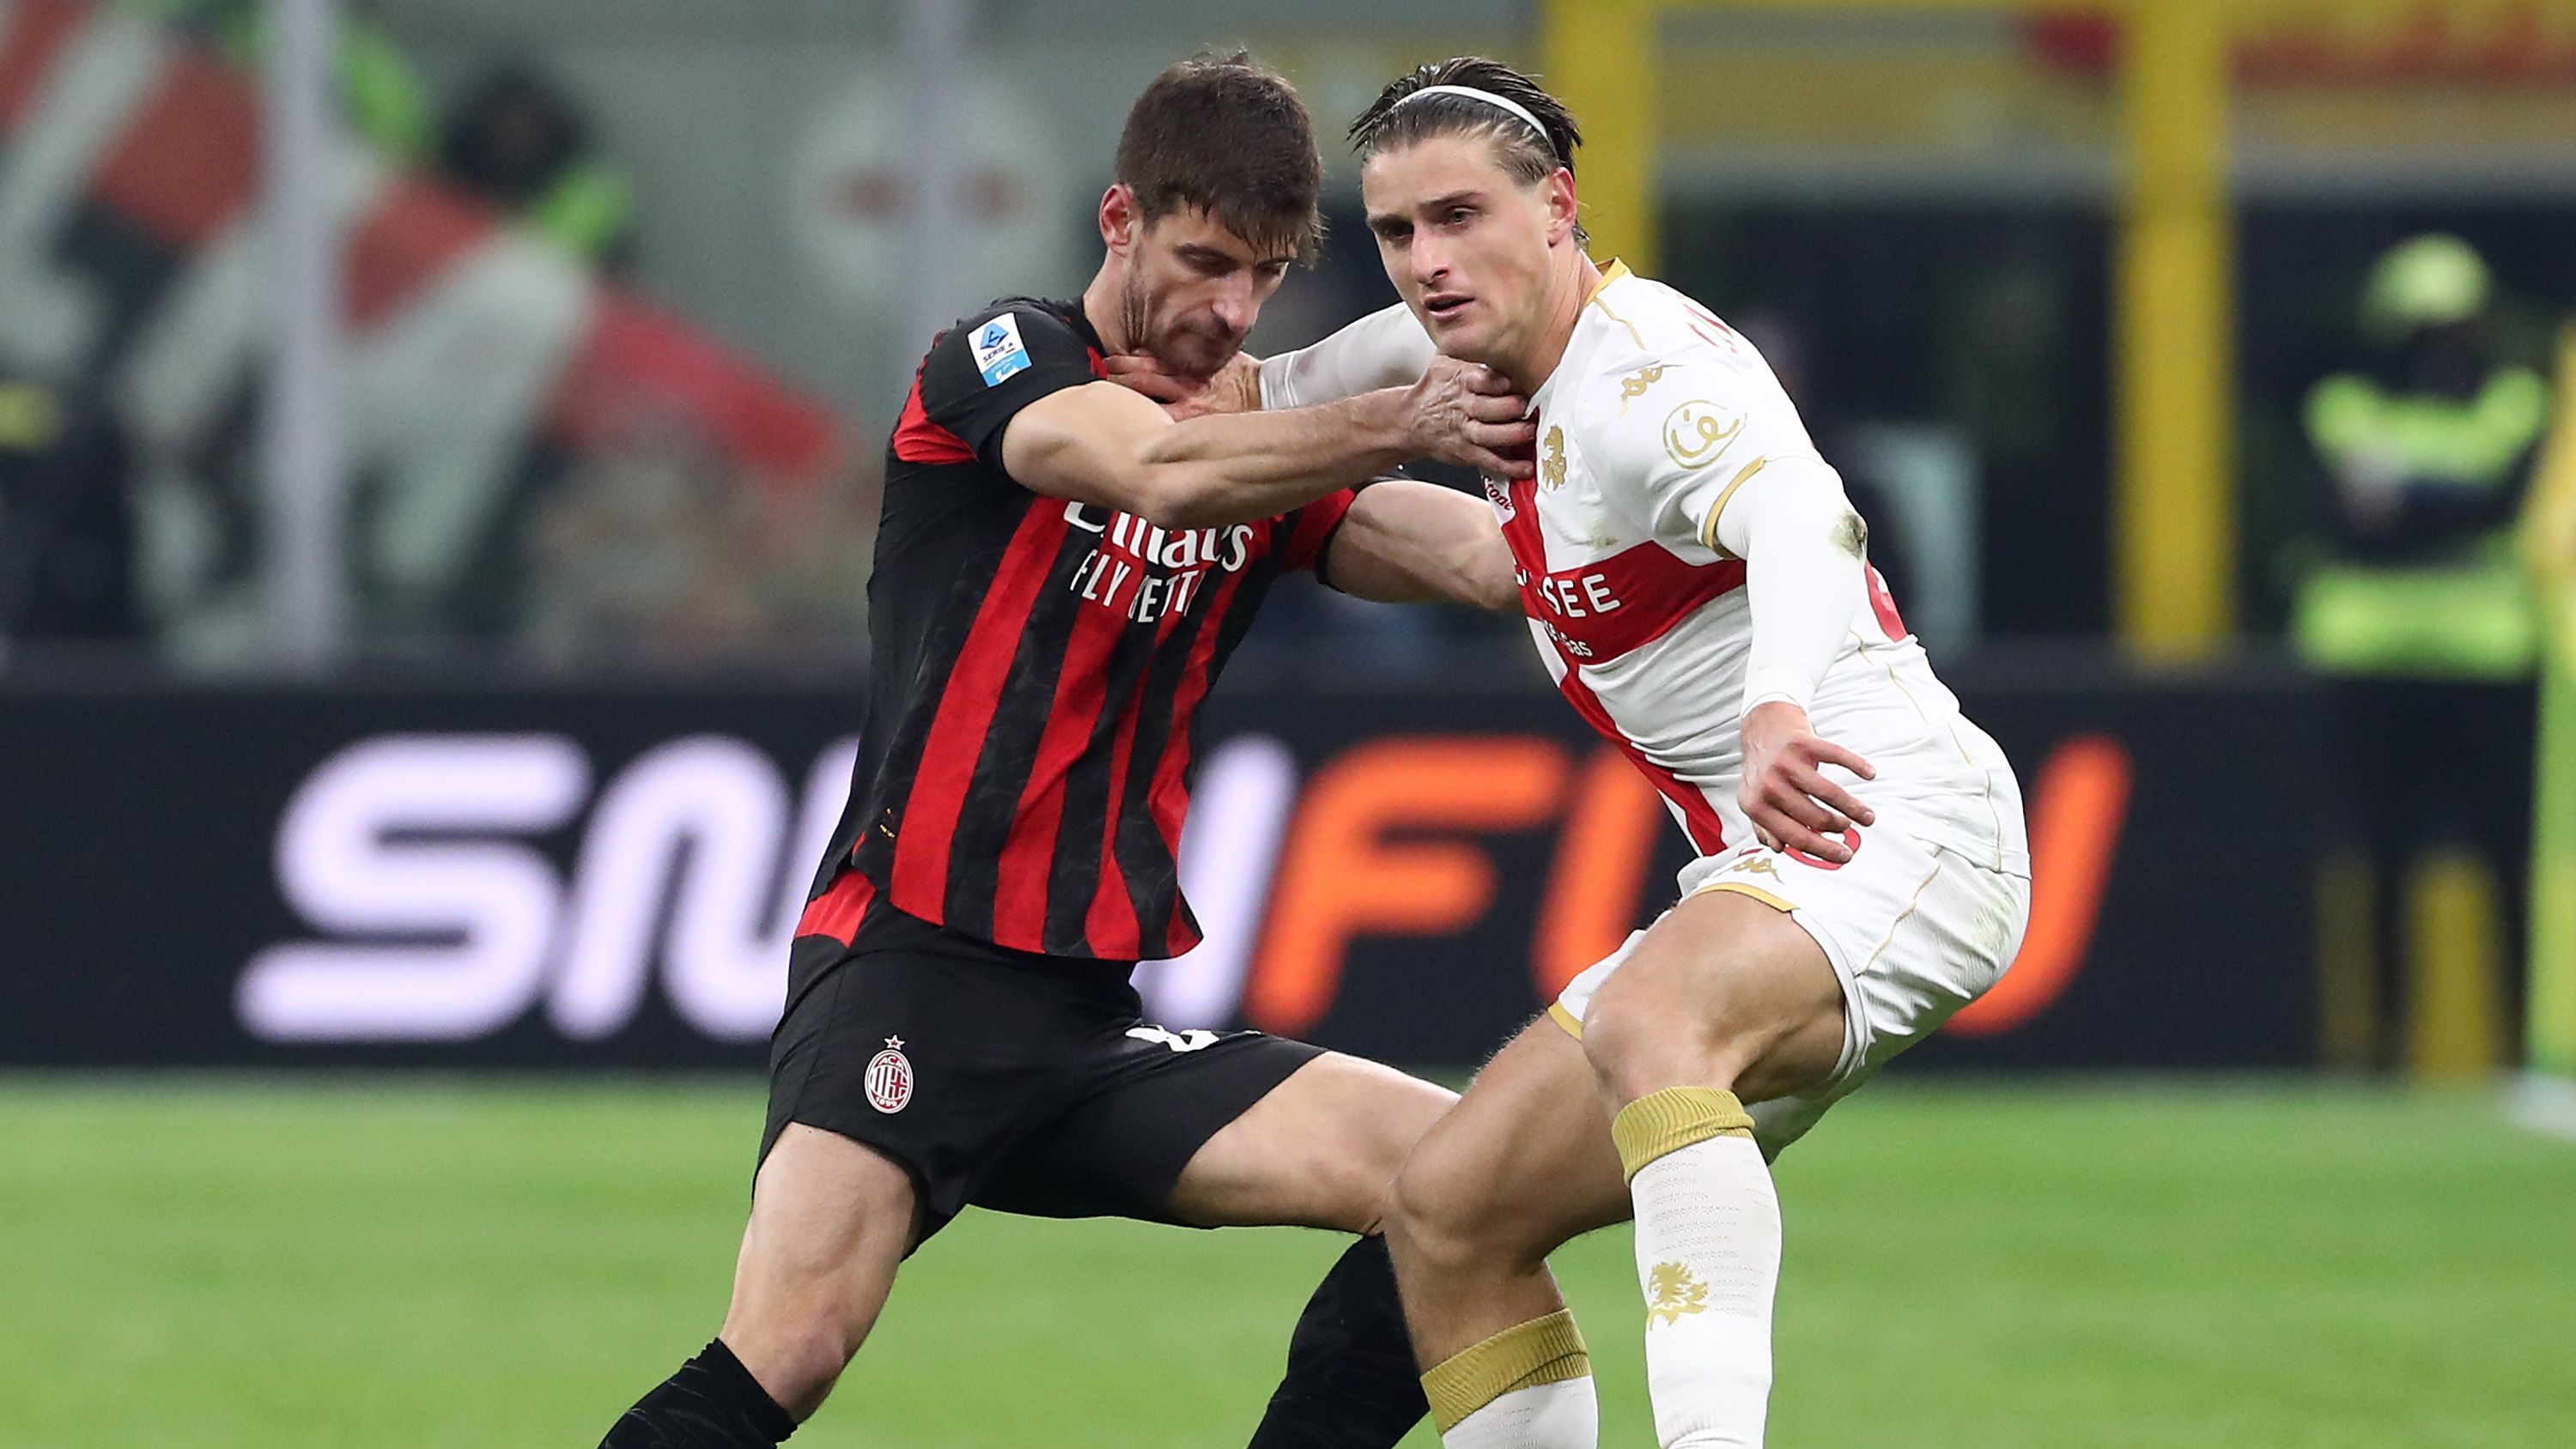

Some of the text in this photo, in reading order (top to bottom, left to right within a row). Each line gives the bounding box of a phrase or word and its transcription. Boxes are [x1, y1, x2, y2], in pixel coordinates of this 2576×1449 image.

[982, 345, 1006, 362] SERIE
[1070, 549, 1131, 607] FLY
[878, 1056, 905, 1071] ACM
